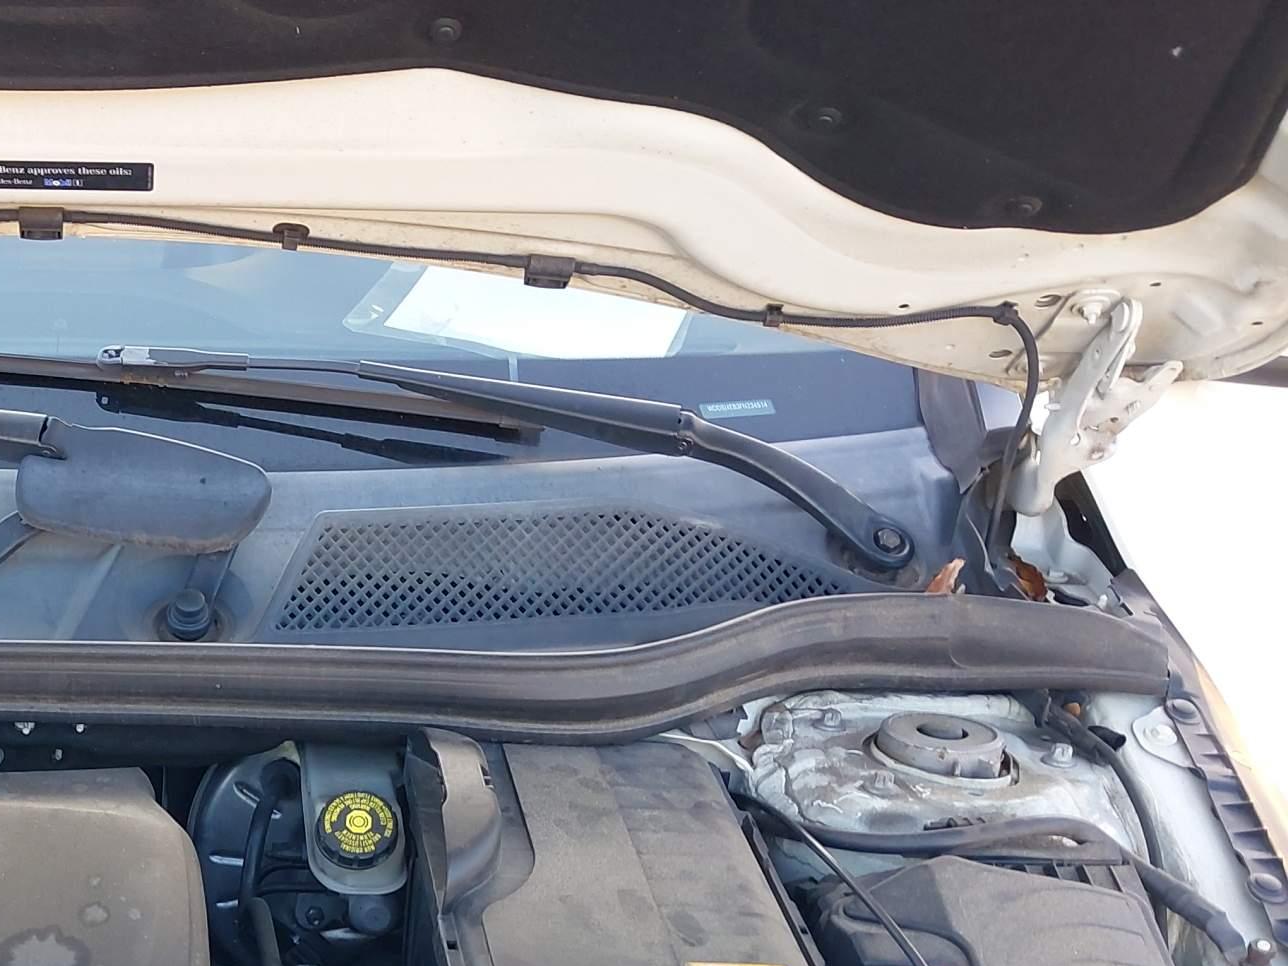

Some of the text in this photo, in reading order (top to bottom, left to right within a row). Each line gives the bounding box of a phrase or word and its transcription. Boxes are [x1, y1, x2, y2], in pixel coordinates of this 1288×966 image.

[27, 166, 76, 177] approves
[78, 167, 107, 176] these
[109, 167, 133, 177] oils:
